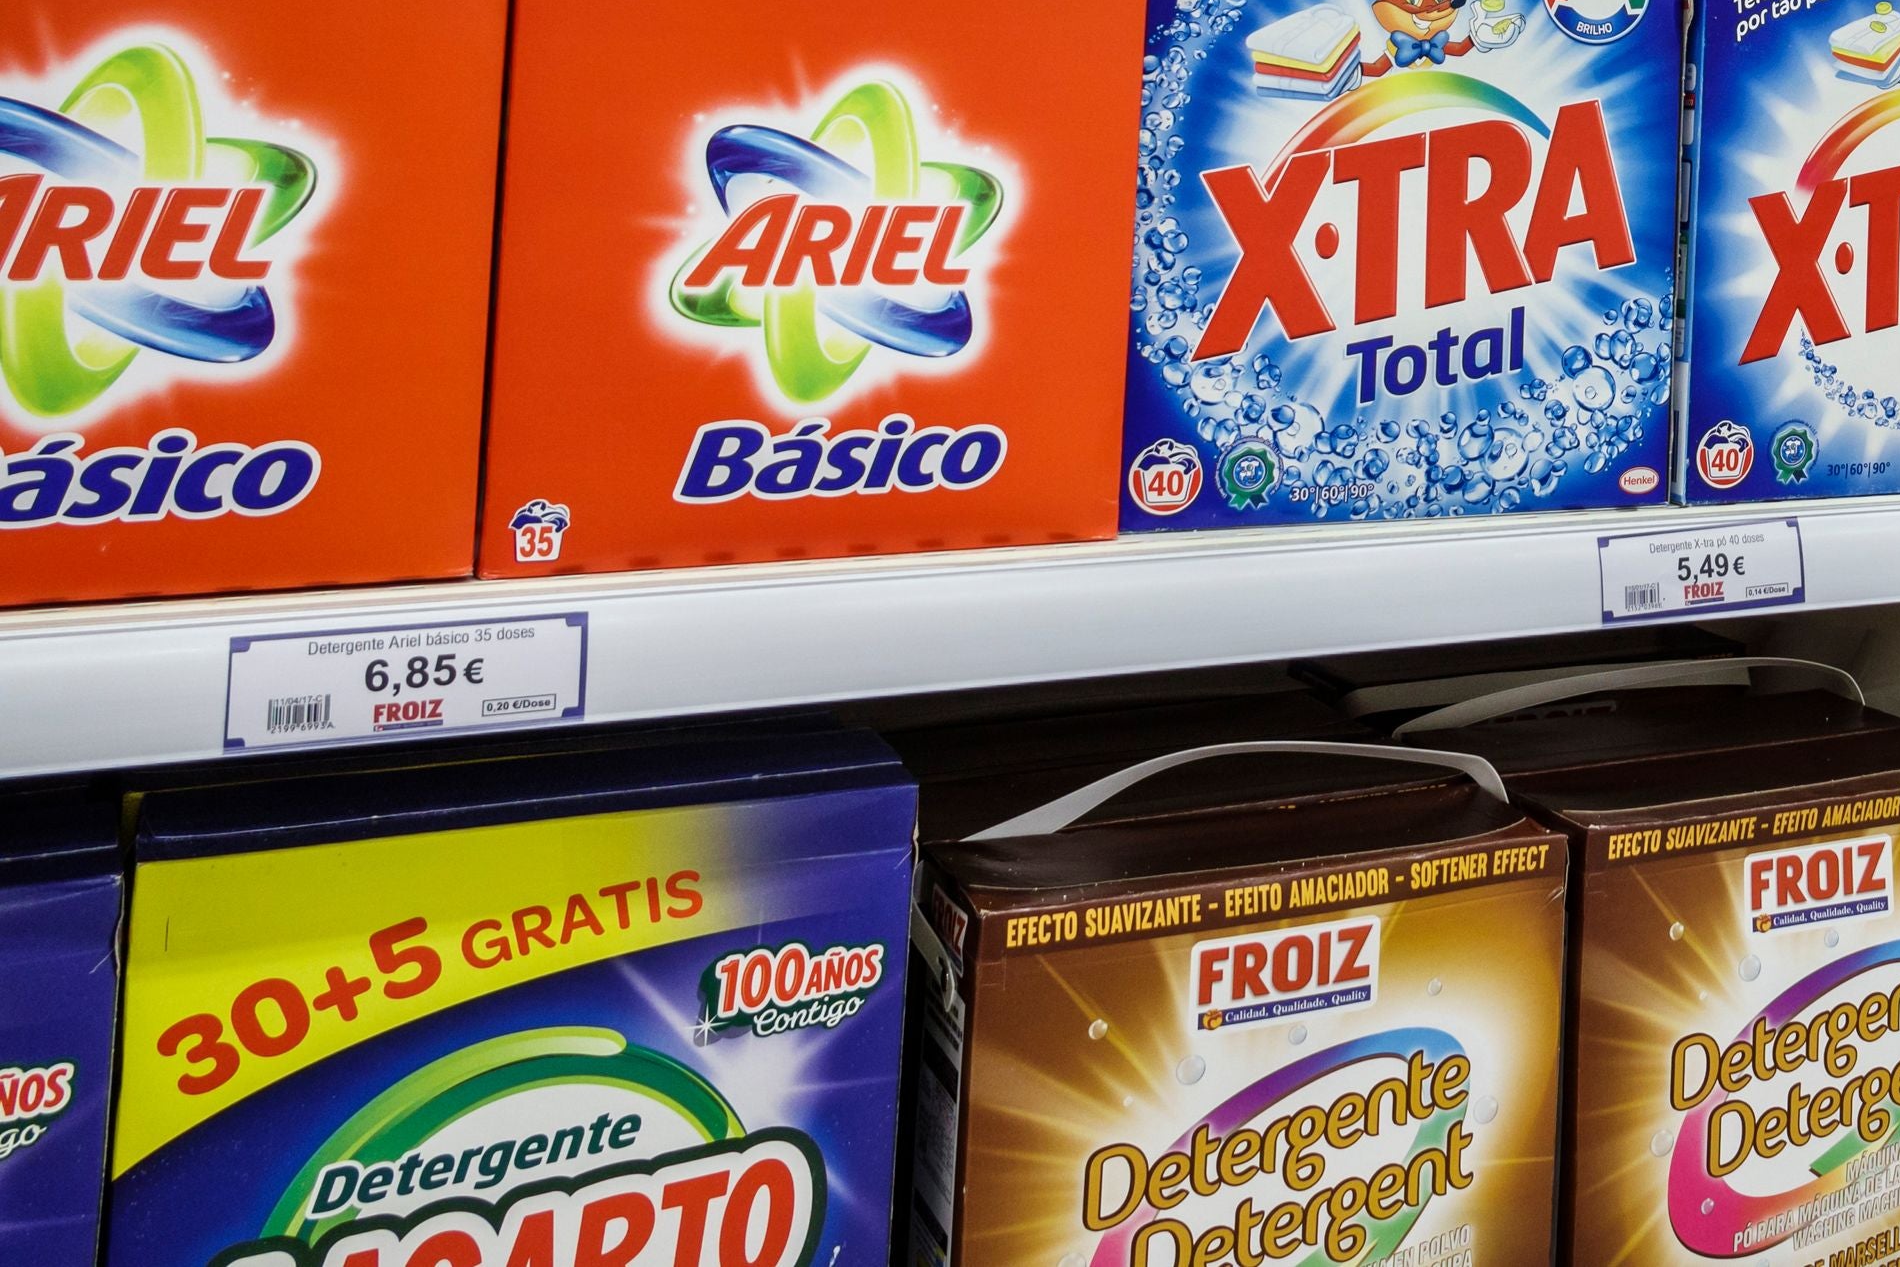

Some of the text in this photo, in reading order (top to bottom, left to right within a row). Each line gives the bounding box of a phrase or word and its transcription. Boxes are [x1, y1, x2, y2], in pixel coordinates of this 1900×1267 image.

[1576, 21, 1613, 36] BRILHO
[1735, 7, 1768, 42] por
[684, 193, 971, 289] ARIEL
[1345, 306, 1524, 406] Total
[680, 418, 1001, 498] Básico
[1148, 467, 1184, 496] 40
[1622, 472, 1655, 487] Henkel
[519, 526, 555, 558] 35
[1650, 533, 1764, 554] Detergente X-tra pó 40 doses
[308, 626, 535, 656] Detergente Ariel básico 35 doses
[373, 699, 443, 723] FROIZ
[486, 697, 551, 712] 0,20 €/Dose
[1608, 831, 1661, 860] EFECTO
[1666, 816, 1757, 851] SUAVIZANTE
[1773, 809, 1817, 835] EFEITO
[1822, 795, 1900, 828] AMACIADOR
[1007, 844, 1549, 950] EFECTO SUAVIZANTE EFEITO AMACIADOR SOFTENER EFFECT
[1750, 841, 1886, 911] FROIZ
[461, 868, 705, 971] GRATIS
[715, 942, 882, 1016] 100 AÑOS
[1199, 924, 1374, 1005] FROIZ
[156, 916, 443, 1097] 30+5
[753, 993, 865, 1037] Contigo
[1224, 988, 1368, 1025] Calidad, Qualidade, Quality
[312, 1110, 643, 1216] Detergente
[1083, 1050, 1471, 1232] Detergente
